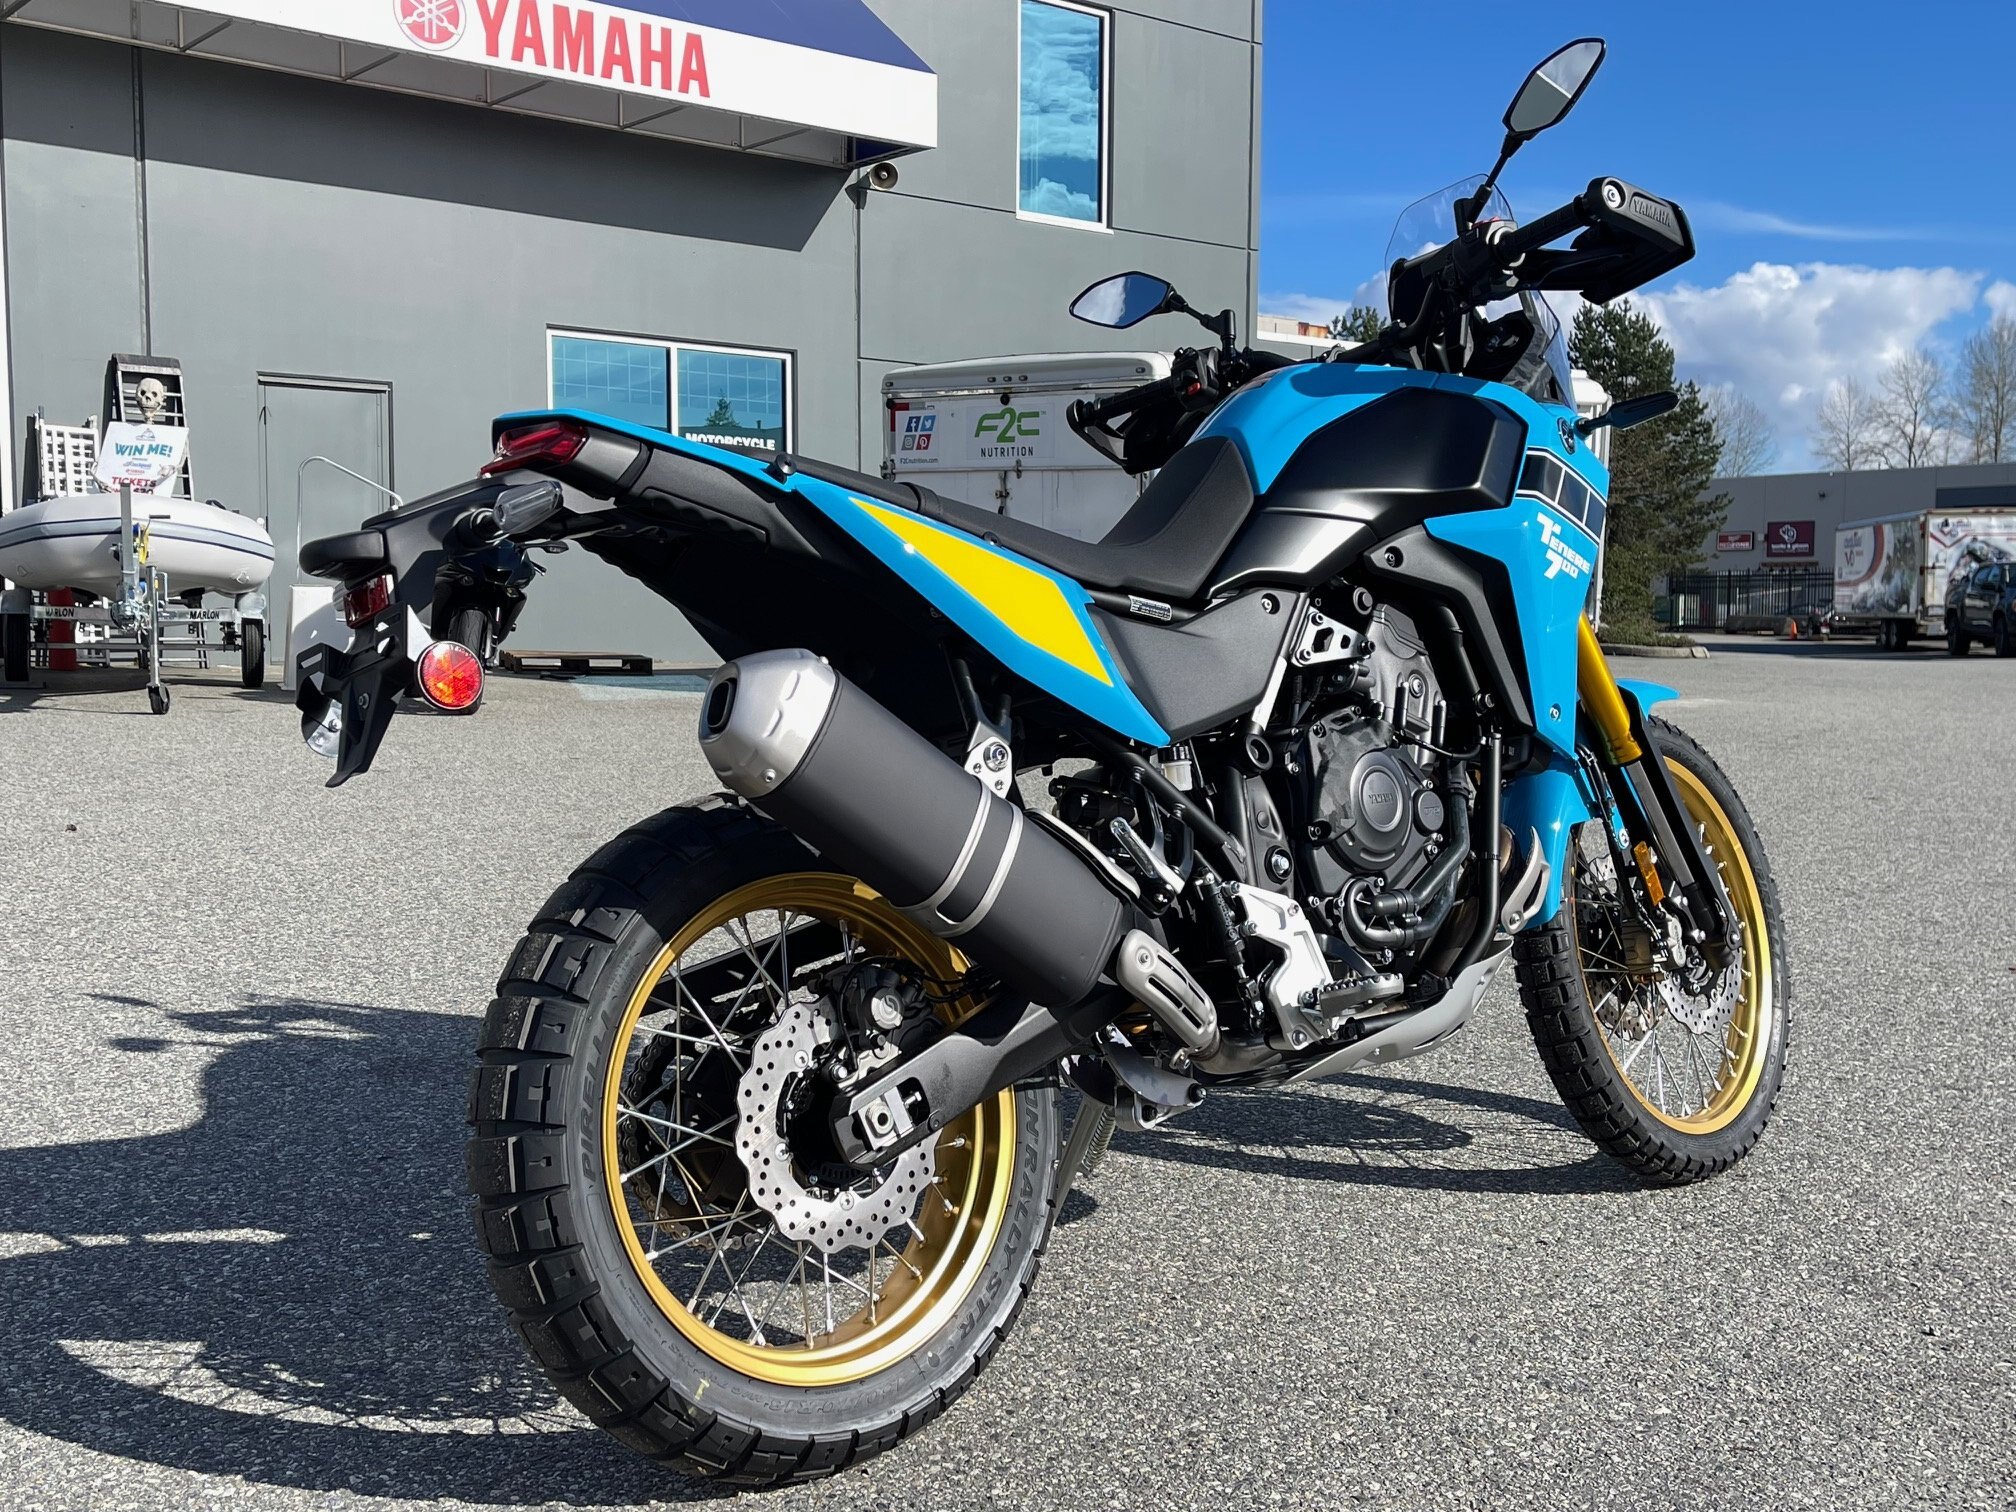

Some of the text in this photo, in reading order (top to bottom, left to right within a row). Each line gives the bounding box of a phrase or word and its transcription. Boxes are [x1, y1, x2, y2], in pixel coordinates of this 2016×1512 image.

[476, 0, 711, 98] YAMAHA
[1633, 198, 1671, 228] YAMAHA
[974, 407, 1040, 443] F2C
[115, 442, 173, 458] WIN ME!
[685, 432, 776, 451] MOTORCYCLE
[980, 446, 1034, 458] NUTRITION
[900, 456, 938, 465] F2Cnutrition.com
[112, 476, 157, 488] TICKETS
[189, 609, 220, 620] MARLON
[581, 1009, 609, 1183] PIRELLI
[1001, 1143, 1037, 1271] RALLY
[958, 1271, 1002, 1341] STR
